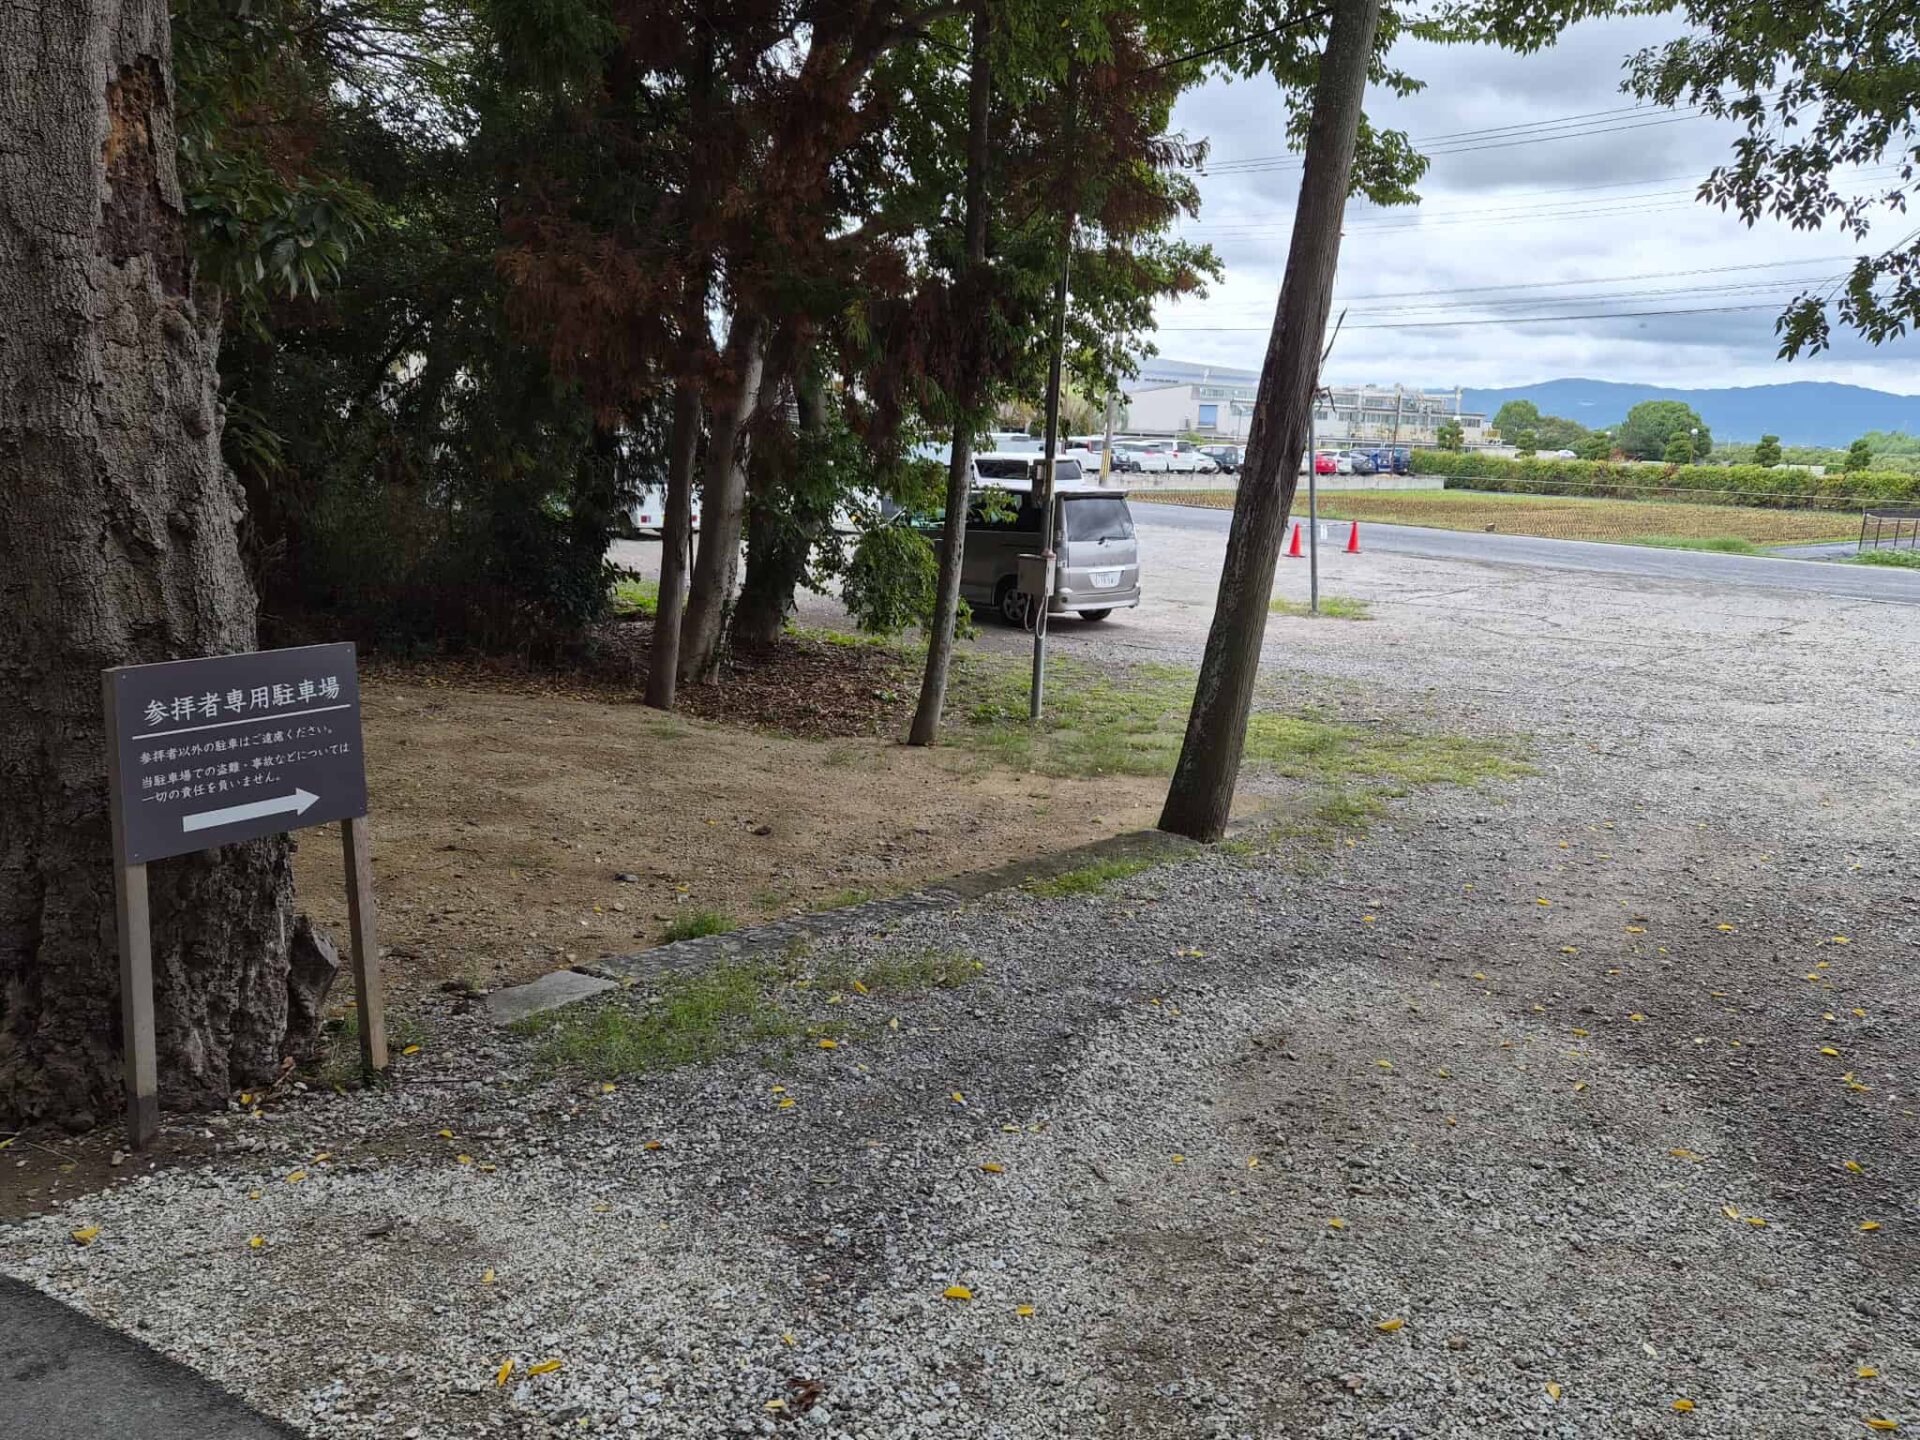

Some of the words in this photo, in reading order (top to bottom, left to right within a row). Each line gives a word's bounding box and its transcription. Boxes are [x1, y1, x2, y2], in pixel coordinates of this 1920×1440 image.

[144, 676, 340, 726] 参拝者専用駐車場
[140, 725, 333, 764] 参拝者以外の駐車はご遠慮ください。
[141, 743, 349, 789] 当駐車場での盗難・事故などについては
[141, 773, 281, 803] 一切の責任を負いません。
